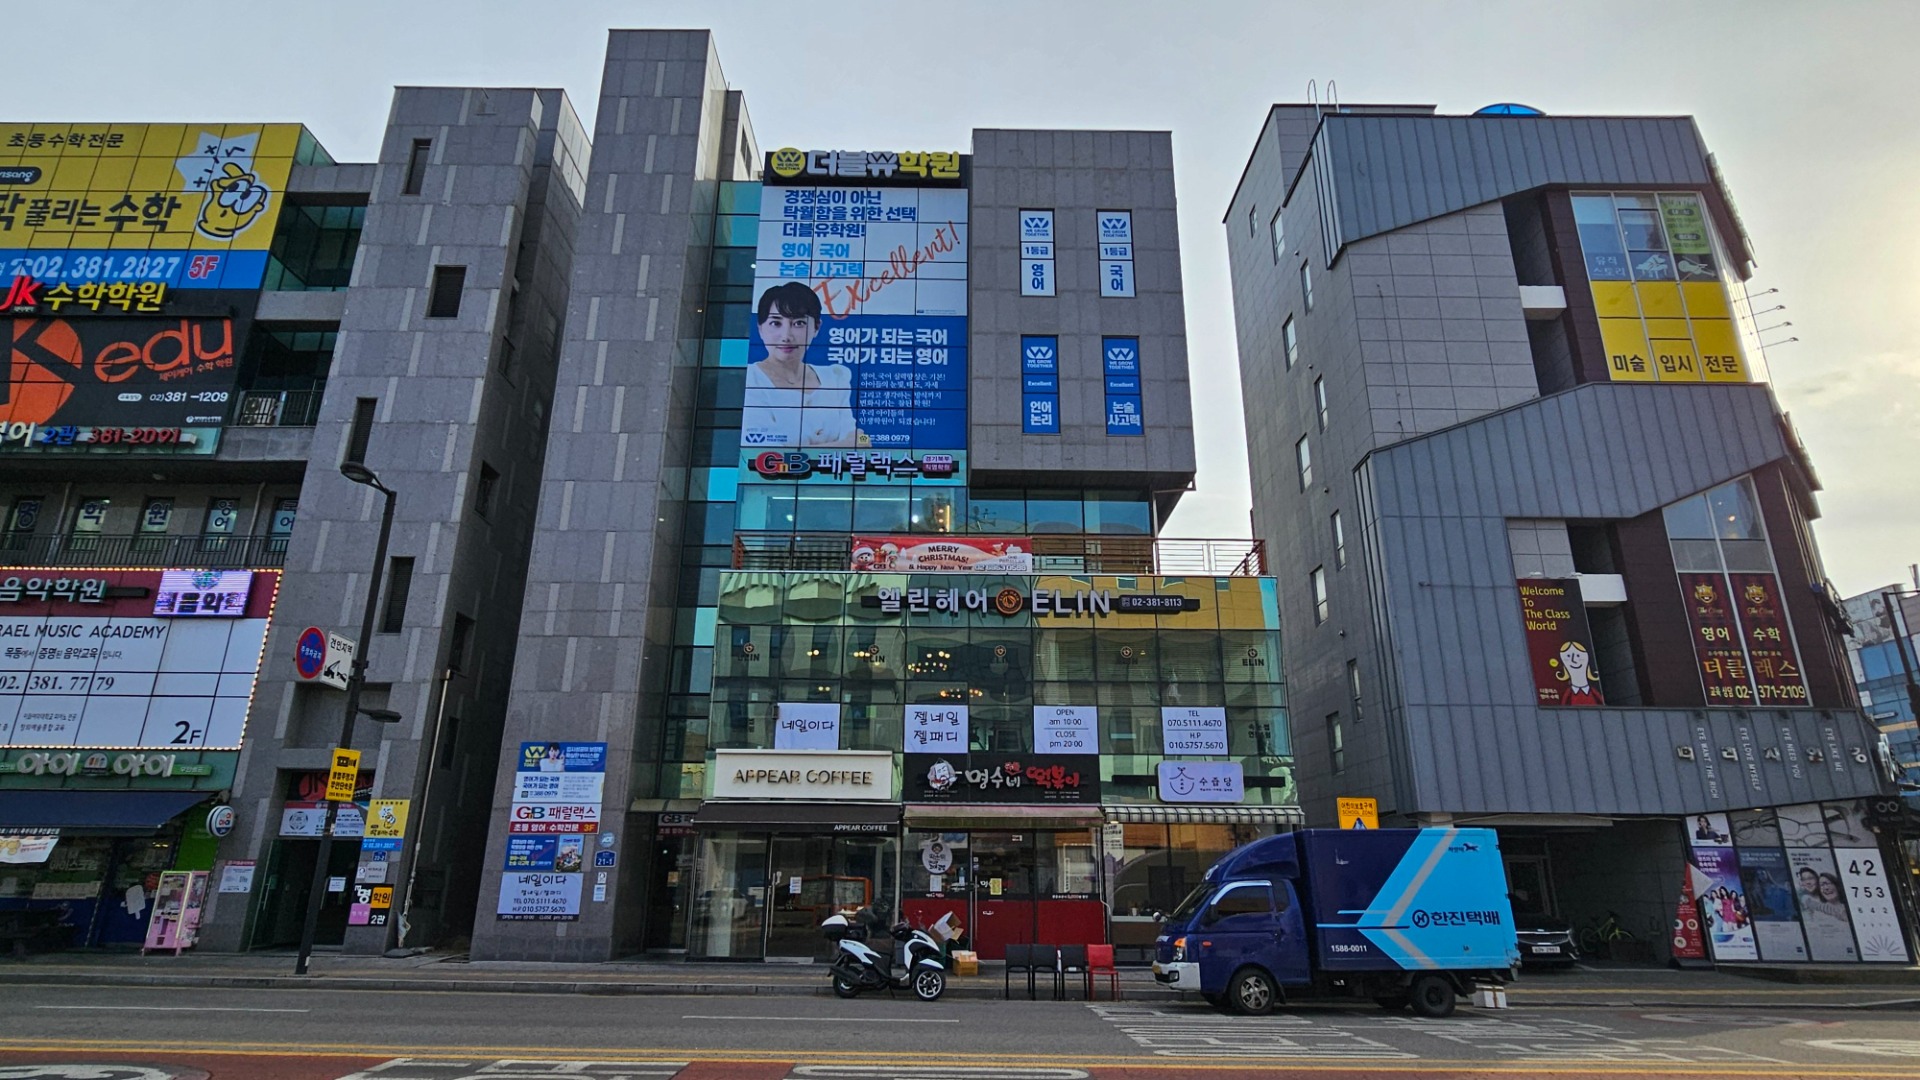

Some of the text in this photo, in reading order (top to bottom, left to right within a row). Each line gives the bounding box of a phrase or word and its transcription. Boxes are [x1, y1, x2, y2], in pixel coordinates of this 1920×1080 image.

[7, 133, 124, 148] 초등수학전문
[785, 190, 882, 205] 경쟁심이 아닌
[104, 192, 181, 231] 수학
[783, 206, 916, 221] 탁월함을 위한 선택
[782, 222, 866, 238] 더블유학원!
[781, 243, 850, 258] 영어 국어
[1025, 246, 1048, 255] 1등급
[1104, 247, 1127, 256] 1등급
[31, 255, 180, 279] 02.381.2827
[188, 255, 219, 279] 5F
[779, 262, 863, 277] 논술 사고력
[813, 220, 961, 320] Excellent!
[1592, 266, 1626, 278] 스토리
[1031, 264, 1044, 290] 영어
[1110, 264, 1123, 291] 국어
[43, 281, 165, 311] 수학학원
[828, 328, 948, 346] 영어가 되는 국어
[94, 318, 233, 382] edu
[827, 347, 948, 366] 국어가 되는 영어
[1613, 355, 1738, 373] 미술 입시 전문
[150, 392, 187, 402] 02)381
[1030, 401, 1052, 413] 언어
[1113, 402, 1135, 414] 논술
[1031, 414, 1052, 426] 논리
[1108, 414, 1141, 426] 사고력
[43, 426, 181, 444] 2관 381-2091
[818, 451, 918, 475] 패럴랙스
[928, 545, 959, 554] MERRY
[918, 553, 969, 563] CHRISTMAS!
[0, 576, 106, 603] 음악학원
[1520, 586, 1564, 596] Welcome
[877, 588, 1110, 614] 엘린헤어 ELIN
[1132, 597, 1182, 607] 02-381-8113
[1522, 598, 1534, 607] To
[1524, 609, 1570, 619] The Class
[35, 625, 166, 639] MUSIC ACADEMY
[1527, 621, 1557, 631] World
[1701, 627, 1781, 642] 영어 수학
[5, 648, 35, 659] 목동에서
[64, 648, 98, 660] 음악교육
[102, 651, 123, 660] 입니다.
[29, 677, 63, 690] 381.
[1709, 686, 1806, 699] 교육 상담 02-371-2109
[782, 719, 834, 733] 네일이다
[914, 711, 960, 726] 젤네일
[1063, 718, 1082, 726] 10:00
[171, 721, 201, 744] 2F
[913, 730, 958, 744] 젤패디
[1169, 741, 1224, 749] 010.5757.5670
[1825, 727, 1844, 772] EYE LIKE ME
[1697, 727, 1715, 783] EYE WANT THE
[1739, 727, 1762, 791] EYE LOVE MYSELF
[1782, 727, 1802, 779] EYE NEED YOU
[17, 752, 176, 778] 아이 아이
[733, 769, 873, 785] APPEAR COFFEE
[964, 765, 1080, 790] 명수네 떡볶이
[548, 806, 596, 820] 패럴랙스
[597, 858, 613, 866] 21-1
[518, 874, 567, 887] 네일이다
[373, 890, 390, 903] 학원
[371, 914, 385, 925] 2관
[1430, 911, 1501, 927] 한진택배
